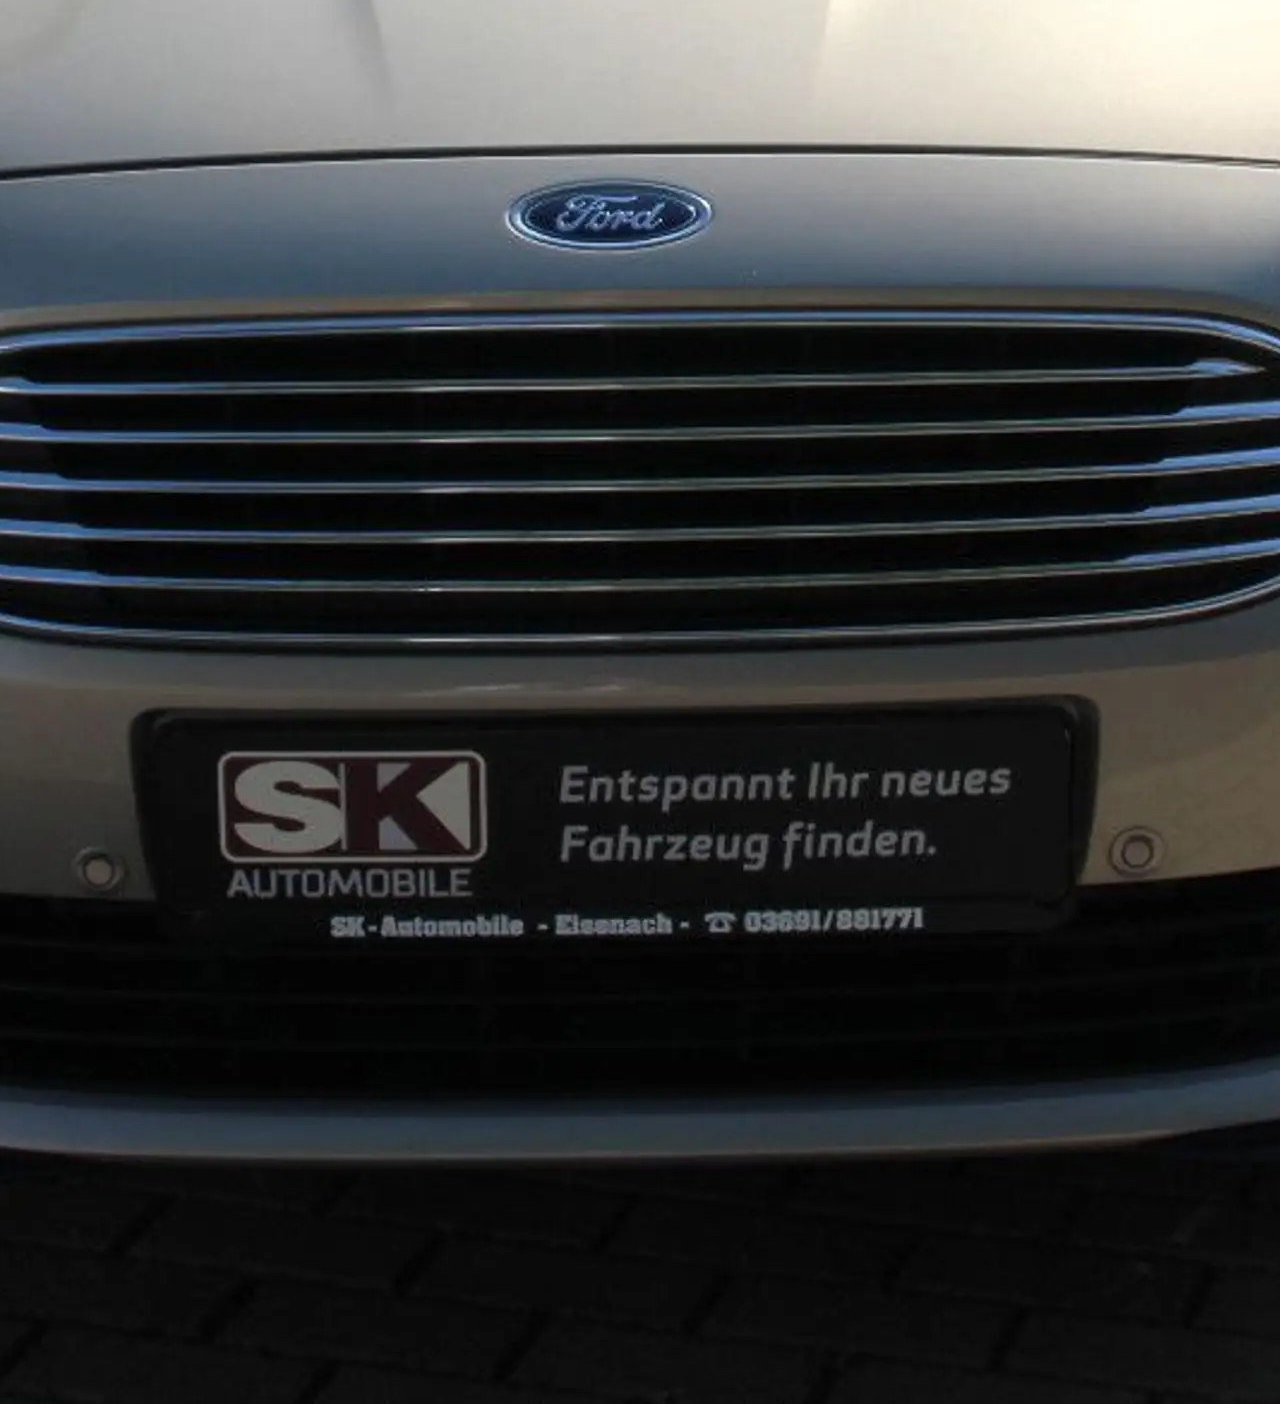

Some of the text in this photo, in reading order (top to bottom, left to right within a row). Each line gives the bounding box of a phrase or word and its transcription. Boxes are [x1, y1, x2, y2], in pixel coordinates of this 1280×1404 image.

[555, 193, 666, 233] Ford
[233, 760, 472, 855] SK
[557, 761, 1013, 814] Entspannt Ihr neues
[558, 819, 938, 873] Fahrzeug finden.
[226, 867, 475, 900] AUTOMOBILE
